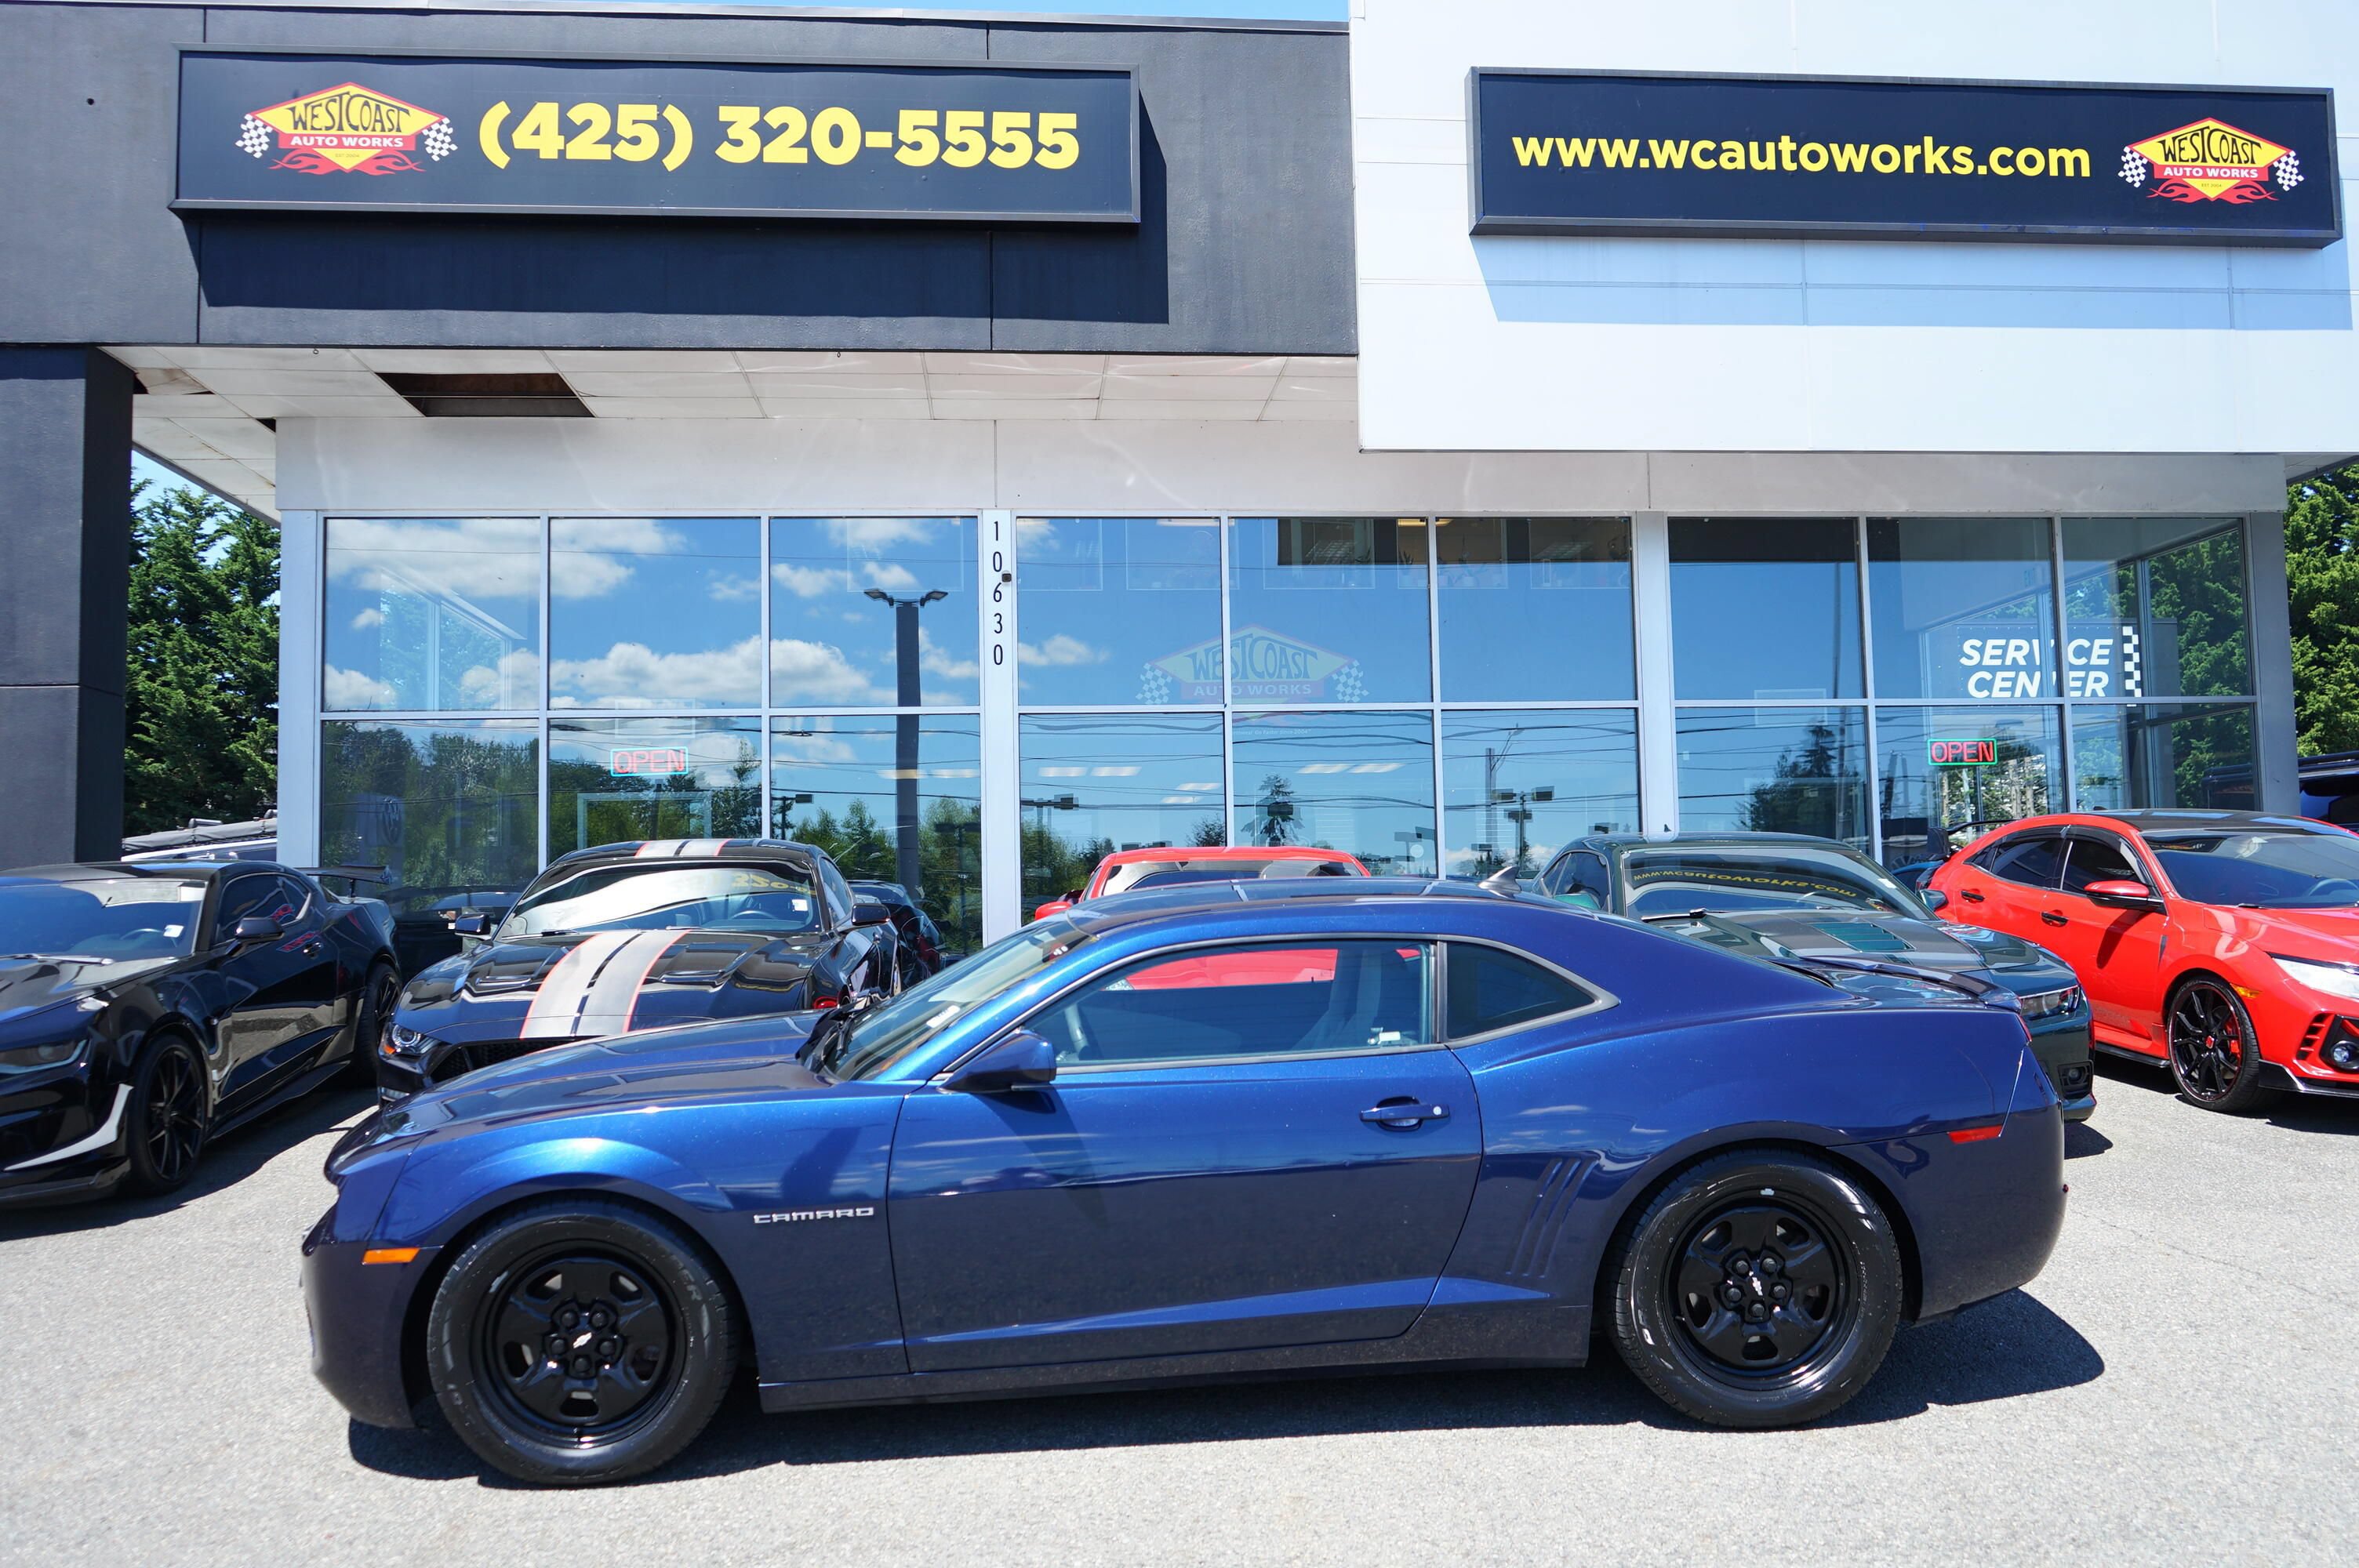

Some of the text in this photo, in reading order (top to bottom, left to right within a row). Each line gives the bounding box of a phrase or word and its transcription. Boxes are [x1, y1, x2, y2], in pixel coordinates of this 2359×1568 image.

[290, 135, 405, 148] AUTO WORKS
[479, 100, 1080, 172] (425) 320-5555
[1512, 134, 2092, 177] www.wcautoworks.com
[2163, 167, 2259, 179] AUTO WORKS
[993, 521, 1003, 666] 10630
[1959, 637, 2114, 666] SERVCE
[1248, 684, 1312, 695] WORKS
[1967, 670, 2110, 699] CENER
[614, 750, 685, 774] OPEN
[1931, 741, 1994, 763] OPEN
[753, 1206, 874, 1225] CAMARO
